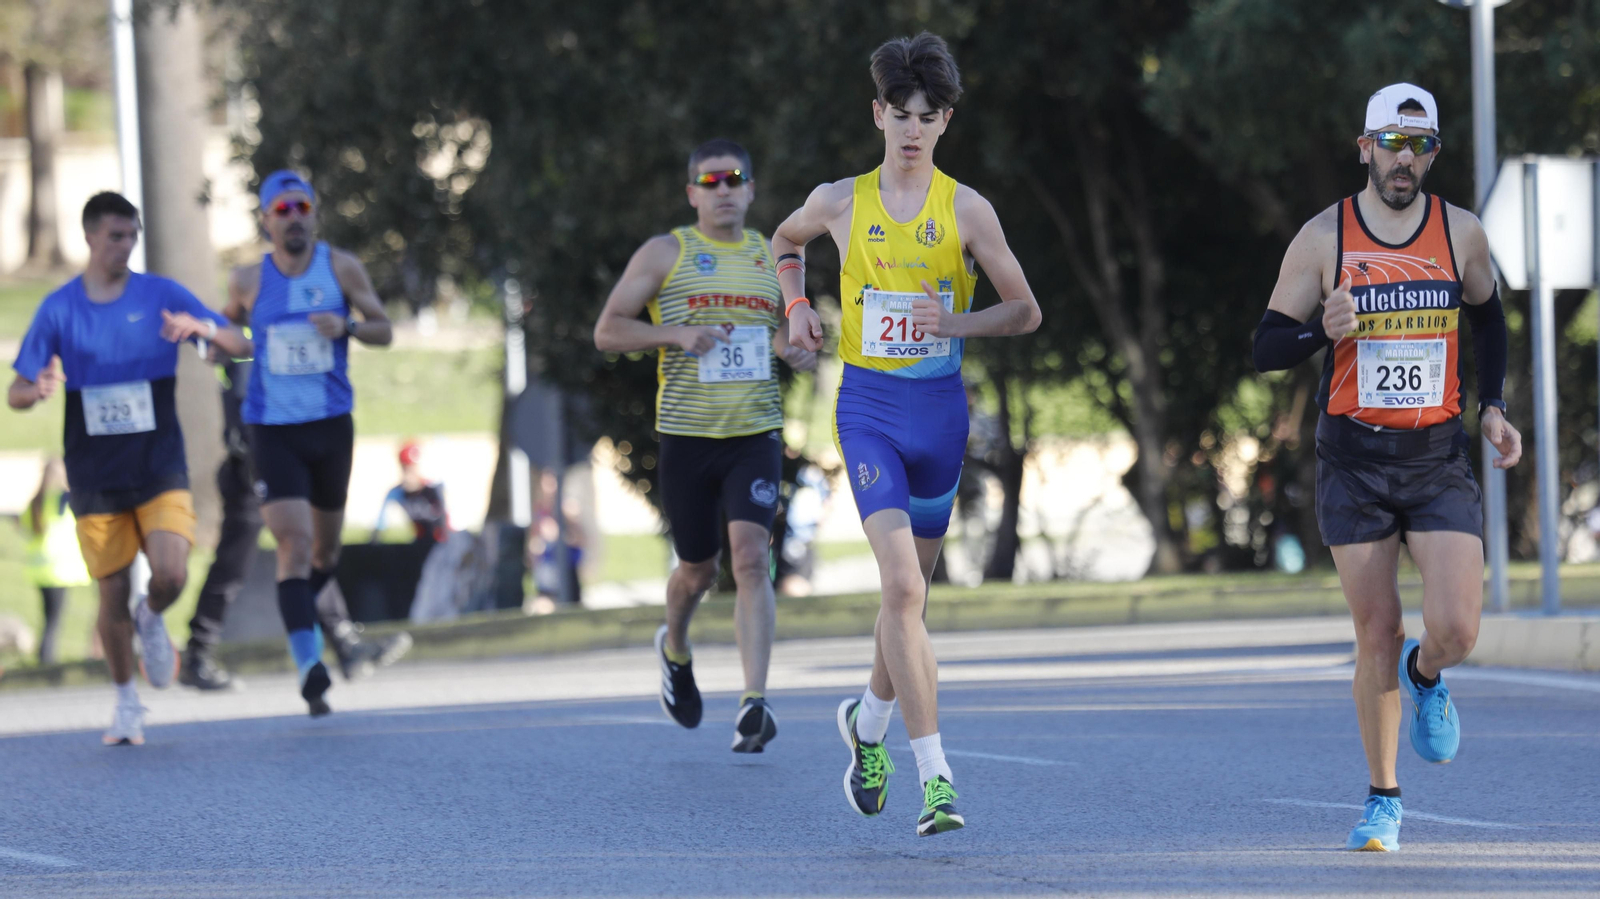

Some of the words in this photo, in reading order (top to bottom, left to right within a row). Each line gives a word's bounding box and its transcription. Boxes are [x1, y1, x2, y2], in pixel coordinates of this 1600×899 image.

[889, 301, 913, 310] MARA
[1352, 319, 1375, 333] OS
[1385, 315, 1448, 331] BARRIOS
[884, 347, 929, 356] EVOS
[1385, 348, 1424, 358] MARATÓN
[721, 346, 744, 368] 36
[1376, 365, 1422, 391] 236
[1382, 396, 1425, 406] EVOS
